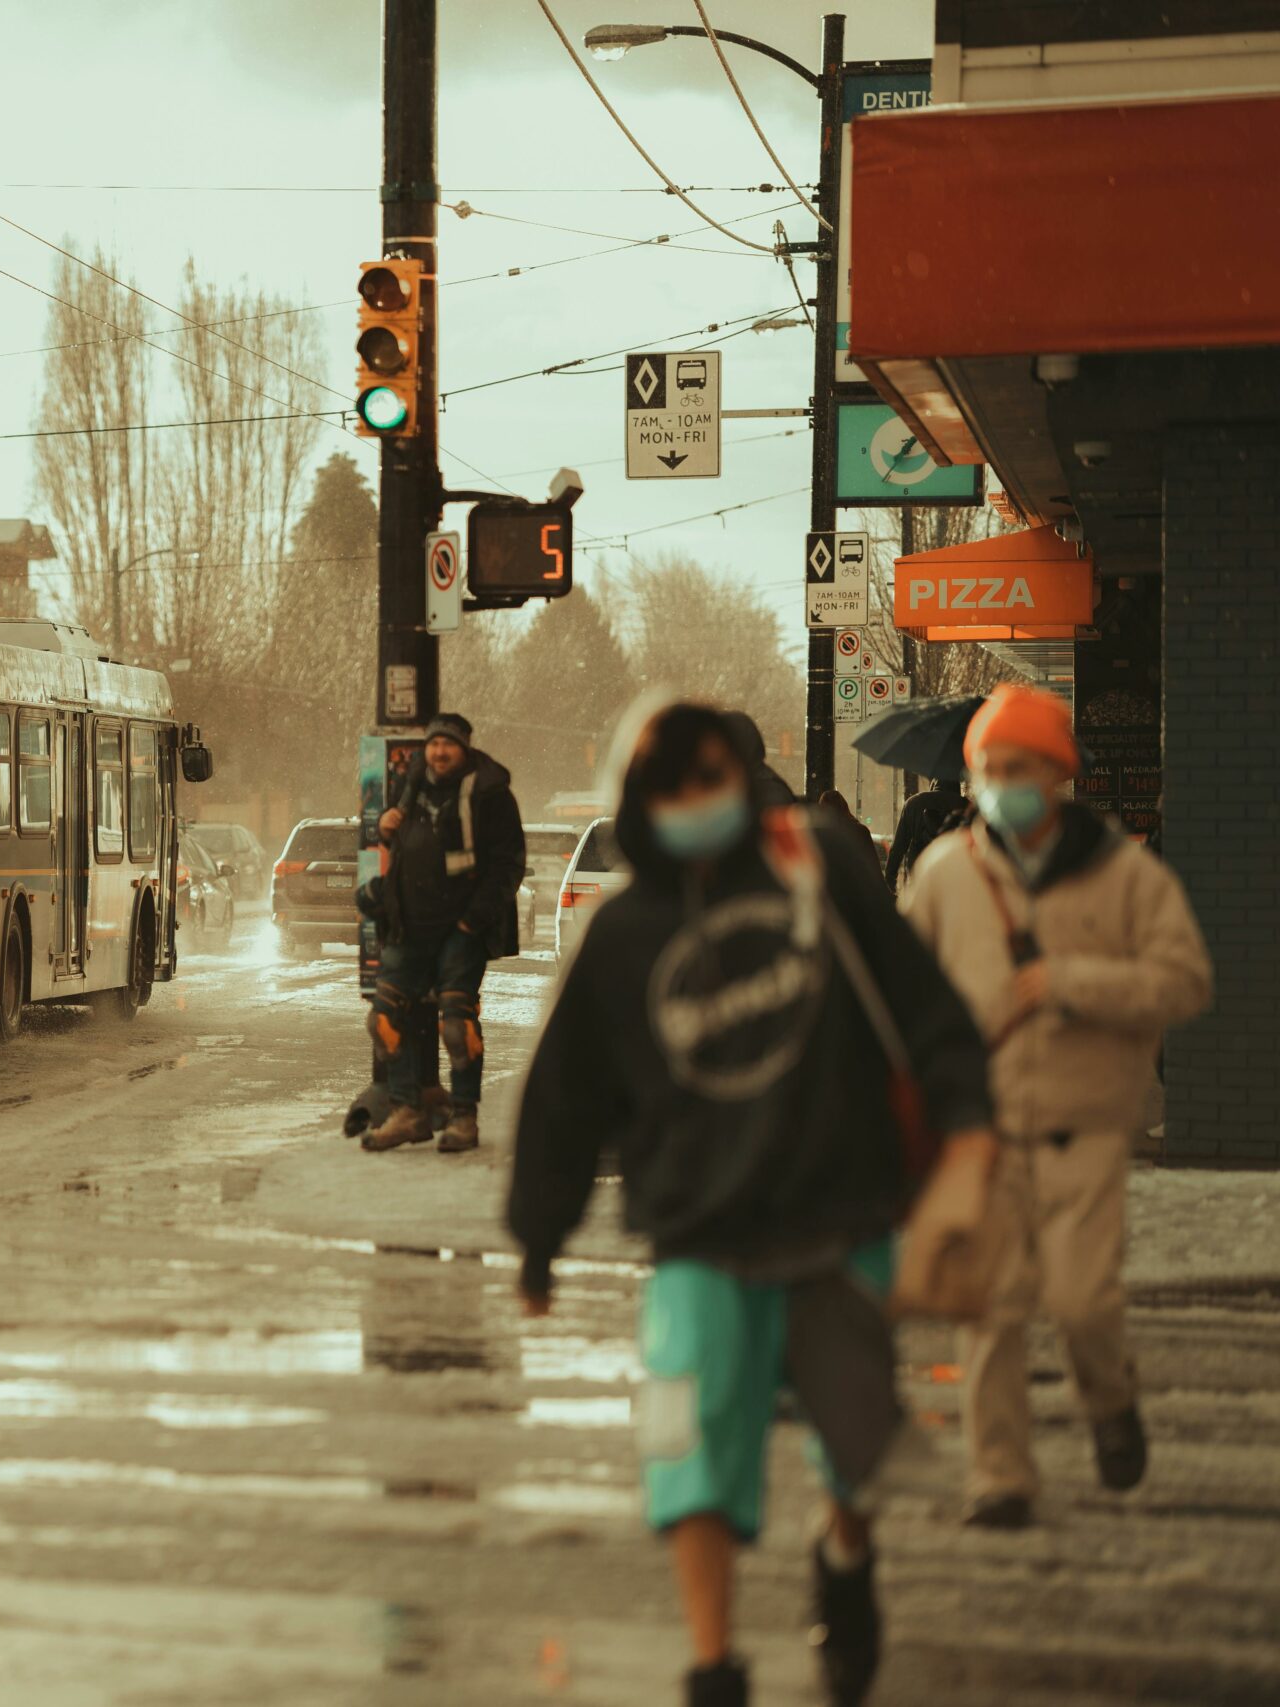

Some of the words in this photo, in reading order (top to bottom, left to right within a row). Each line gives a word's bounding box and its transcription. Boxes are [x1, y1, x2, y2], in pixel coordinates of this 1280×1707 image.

[678, 414, 712, 428] 10AM
[639, 430, 706, 444] MON-FRI
[540, 524, 564, 579] 5
[909, 577, 1035, 609] PIZZA
[815, 602, 859, 611] MON-FRI
